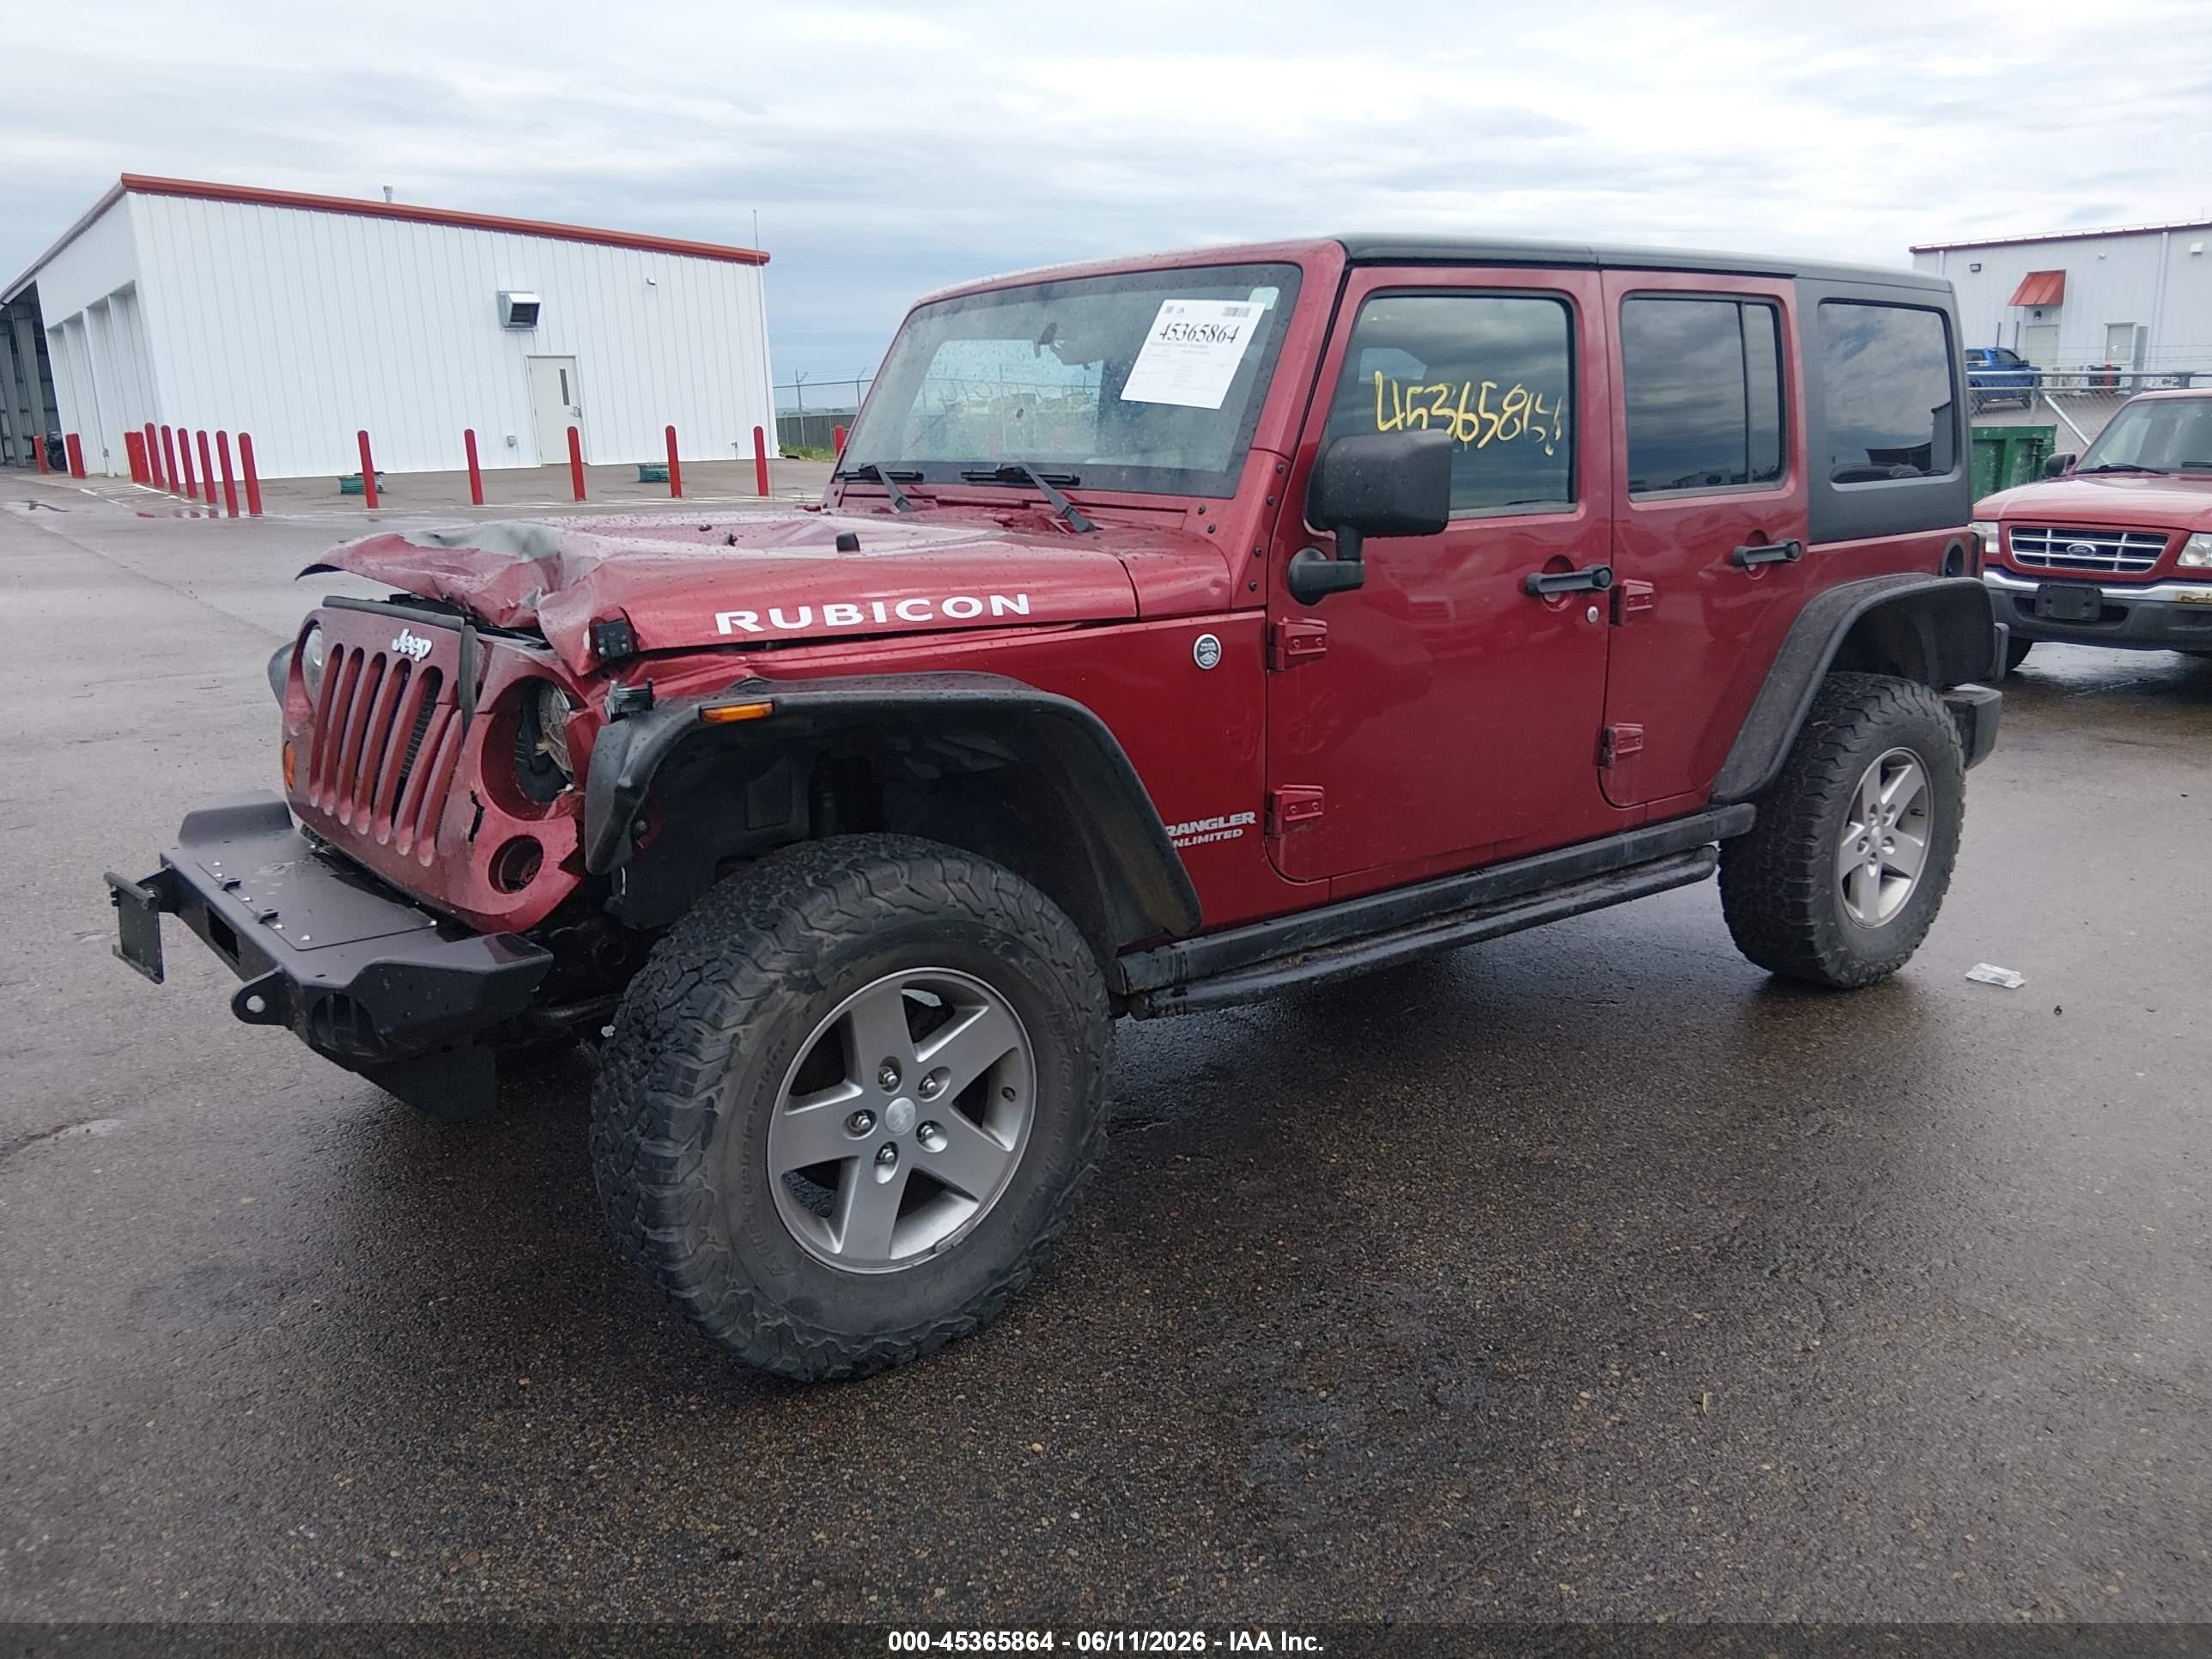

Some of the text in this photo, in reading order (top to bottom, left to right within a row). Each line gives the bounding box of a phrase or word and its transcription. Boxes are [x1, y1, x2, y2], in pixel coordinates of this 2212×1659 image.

[1158, 322, 1241, 344] 45365864
[714, 593, 1030, 635] RUBICON
[391, 628, 433, 663] Jeep
[1164, 811, 1256, 837] RANGLER
[1172, 828, 1243, 848] NLIMITED
